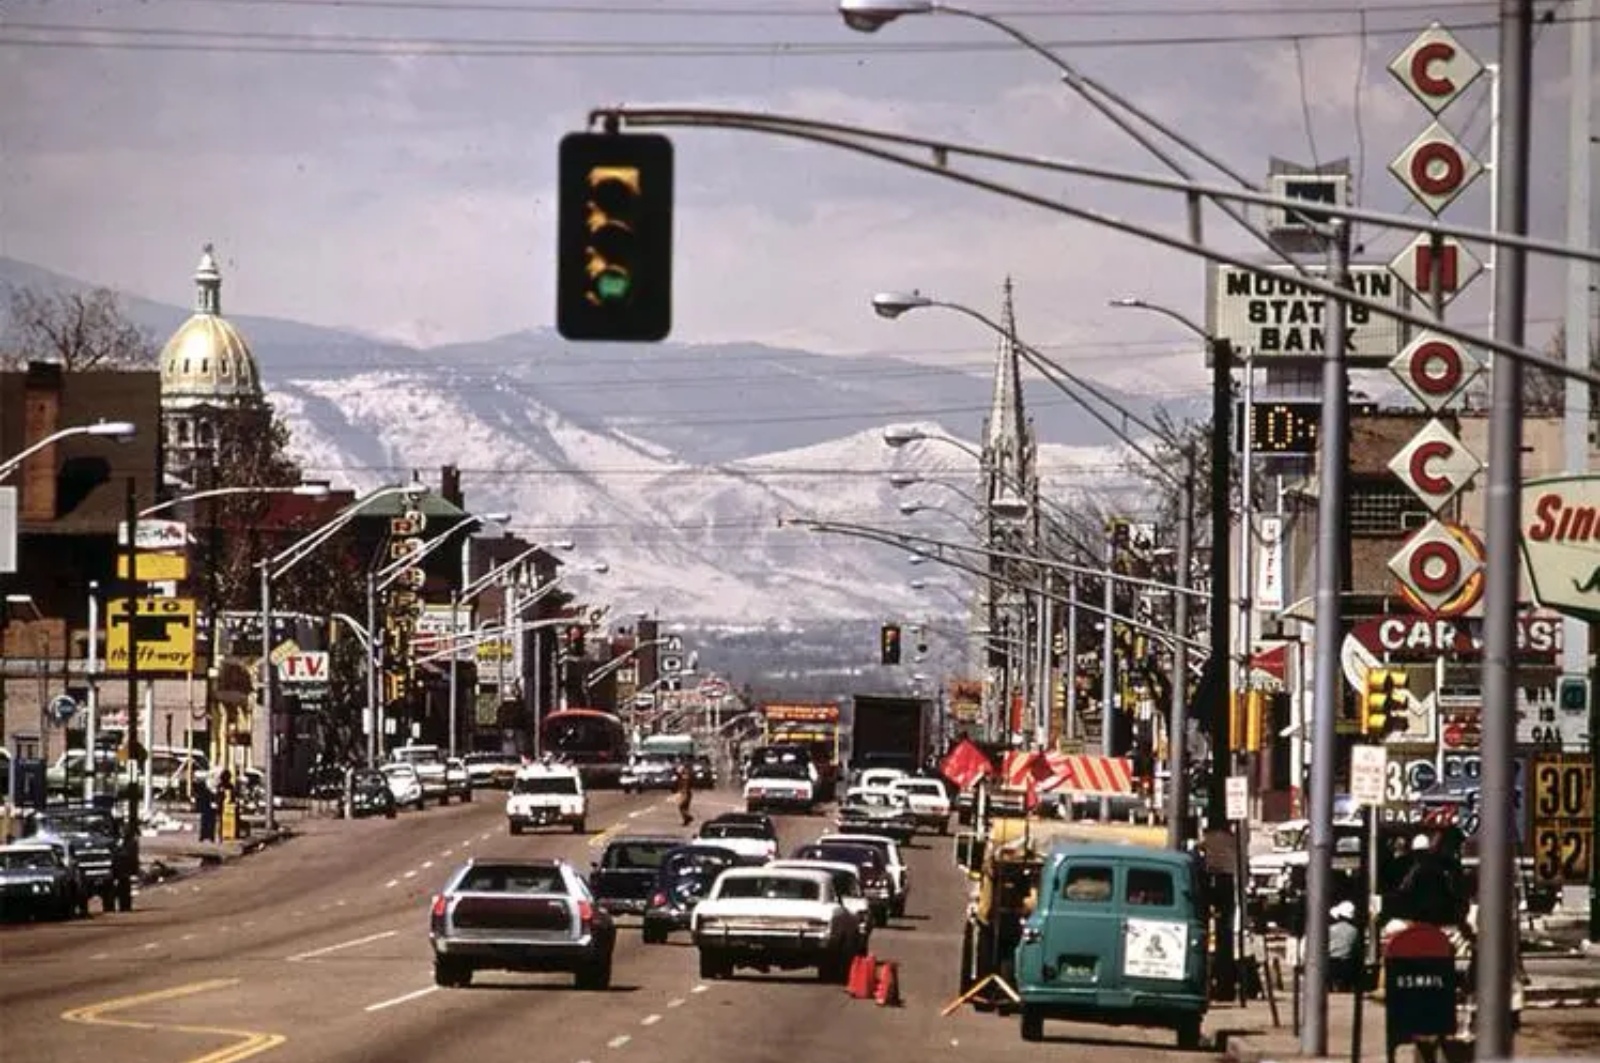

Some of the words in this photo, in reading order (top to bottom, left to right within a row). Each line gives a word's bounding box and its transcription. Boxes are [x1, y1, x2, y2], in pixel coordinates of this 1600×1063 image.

[1227, 273, 1391, 296] MOUAIN
[1249, 301, 1369, 323] STATS
[1409, 42, 1464, 593] CONOCO
[1379, 619, 1457, 649] CAR
[286, 656, 326, 676] T.V.
[1540, 767, 1583, 815] 30
[1540, 831, 1583, 880] 32
